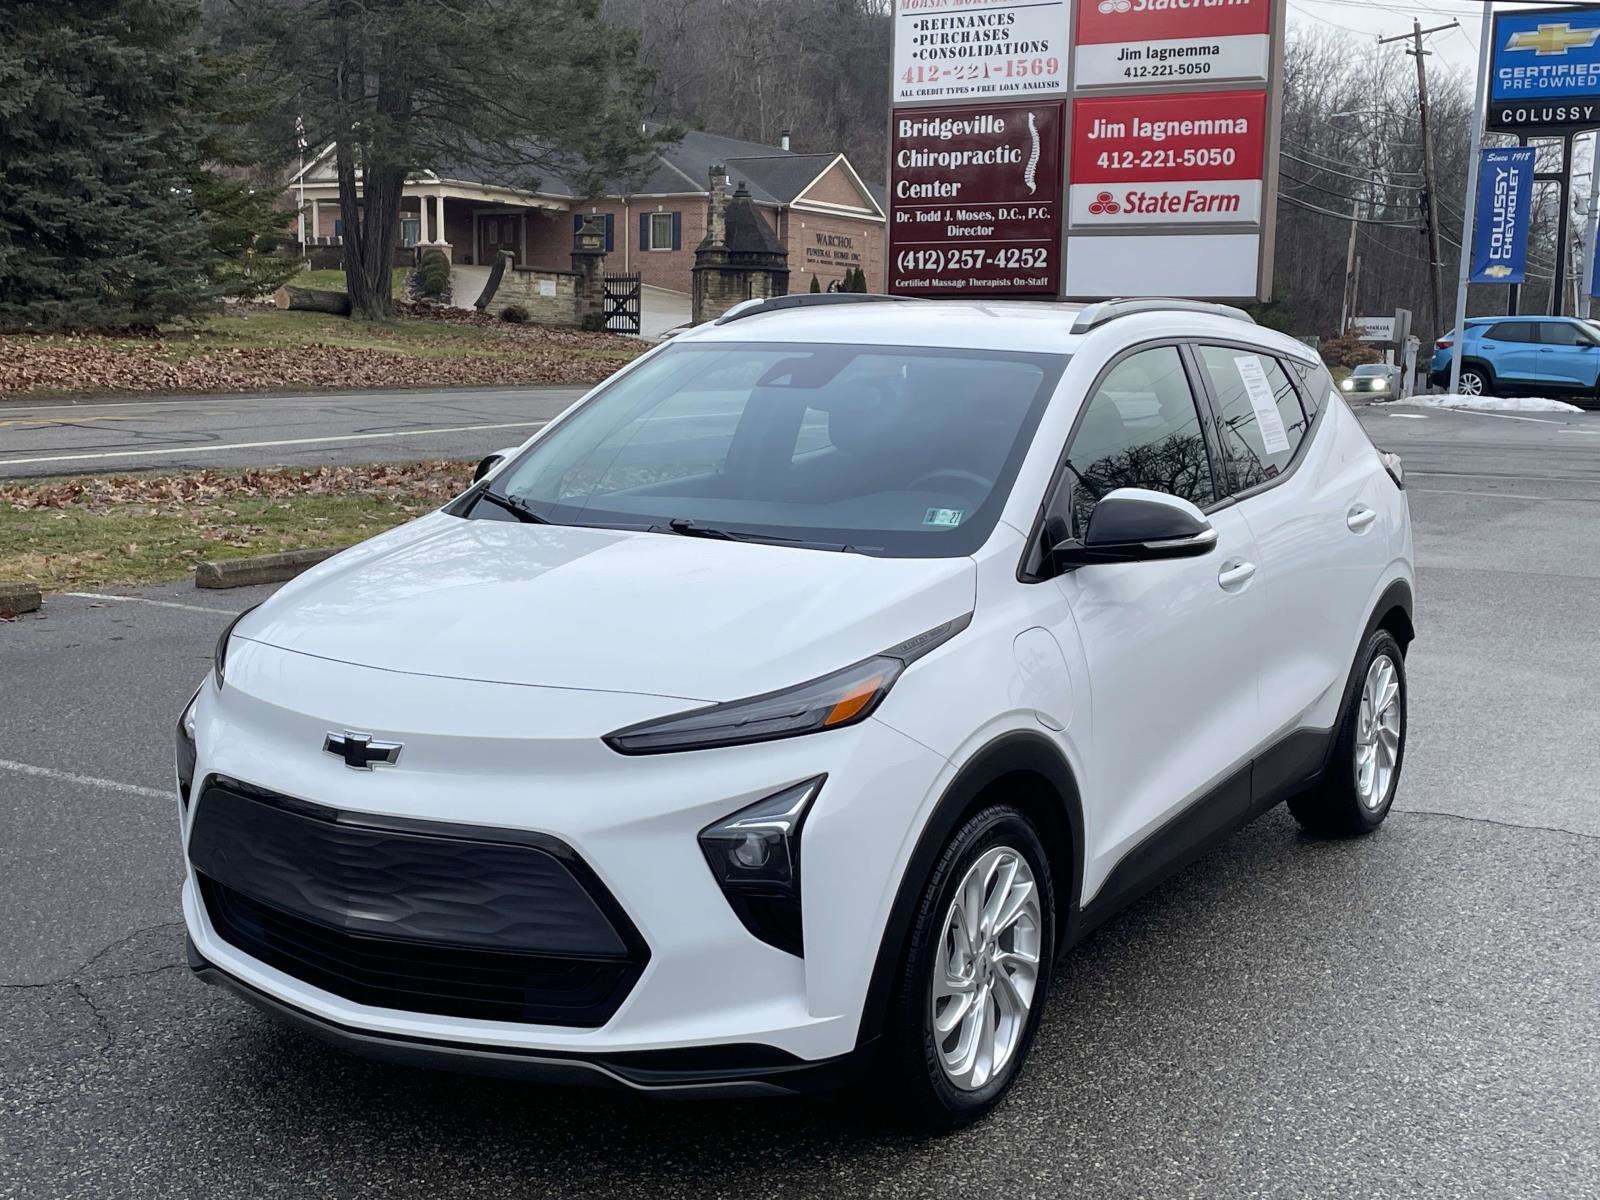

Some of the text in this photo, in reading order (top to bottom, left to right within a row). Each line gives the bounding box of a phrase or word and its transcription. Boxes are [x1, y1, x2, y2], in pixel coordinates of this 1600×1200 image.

[920, 12, 1015, 31] REFINANCES
[919, 28, 1010, 46] PURCHASES
[919, 40, 1049, 60] CONSOLIDATIONS
[1117, 47, 1142, 61] Jim
[901, 57, 1059, 83] 412-221-1569
[1124, 62, 1211, 78] 412-221-5050
[1499, 63, 1600, 79] CERTIFIED
[900, 80, 1060, 97] ALL CREDIT TYPES FREE LOAN ANALYSIS
[1503, 75, 1597, 90] PRE-OWNED
[1501, 106, 1594, 122] COLUSSY
[899, 115, 1005, 140] Bridgeville
[1087, 118, 1126, 139] Jim
[897, 144, 1022, 170] Chiropractic
[1097, 147, 1236, 169] 412-221-5050
[1487, 152, 1531, 162] Since 1918
[896, 180, 962, 199] Center
[896, 207, 1051, 223] Dr. Todd J. Moses, D.C., P.C.
[1489, 167, 1509, 259] COLUSSY
[1502, 166, 1519, 259] CHEVROLET
[947, 225, 995, 237] Director
[815, 233, 853, 249] WARCHOL
[895, 277, 1049, 288] Certified Massage Therapists On-Staff
